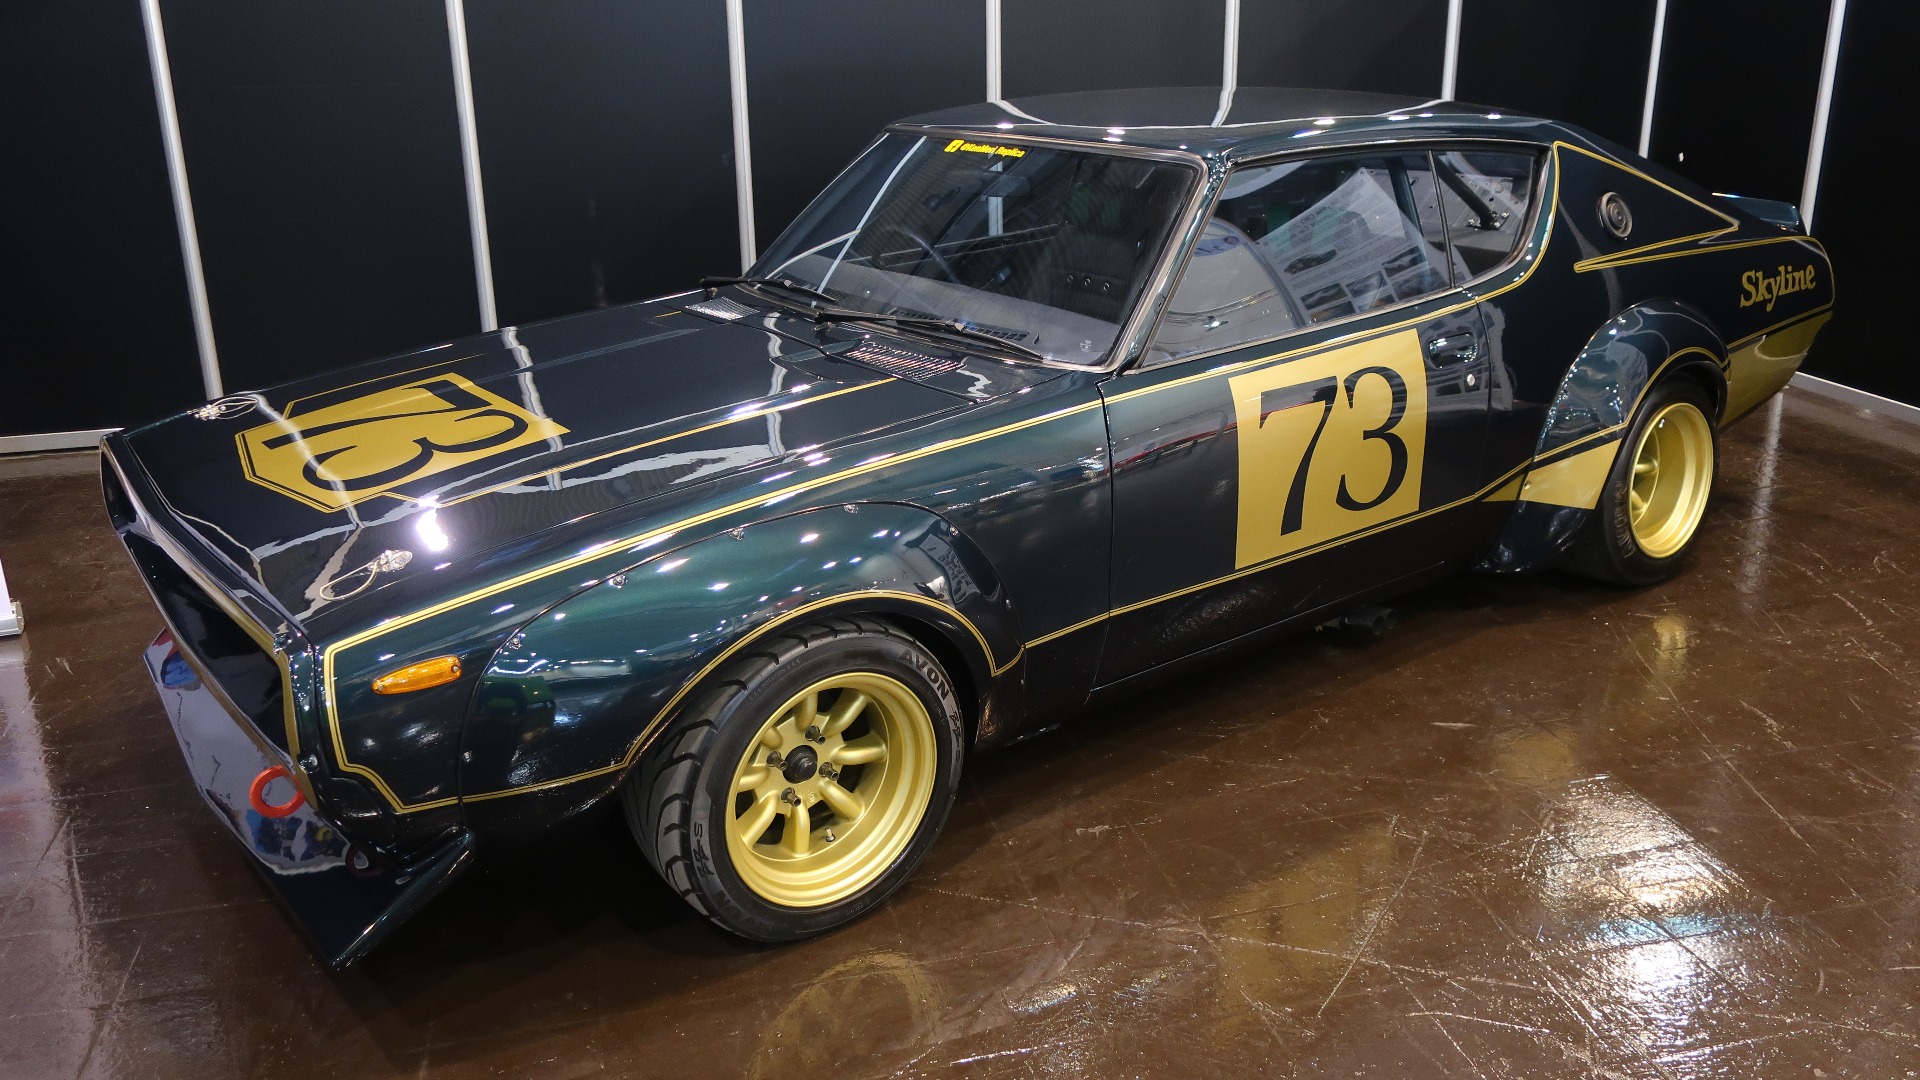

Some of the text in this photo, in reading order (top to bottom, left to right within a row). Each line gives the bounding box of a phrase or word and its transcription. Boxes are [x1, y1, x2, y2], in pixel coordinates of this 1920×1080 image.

[995, 146, 1026, 158] Replica
[1740, 264, 1816, 312] Skyline
[261, 379, 528, 492] 73
[1259, 365, 1408, 536] 73
[899, 648, 950, 701] AVON
